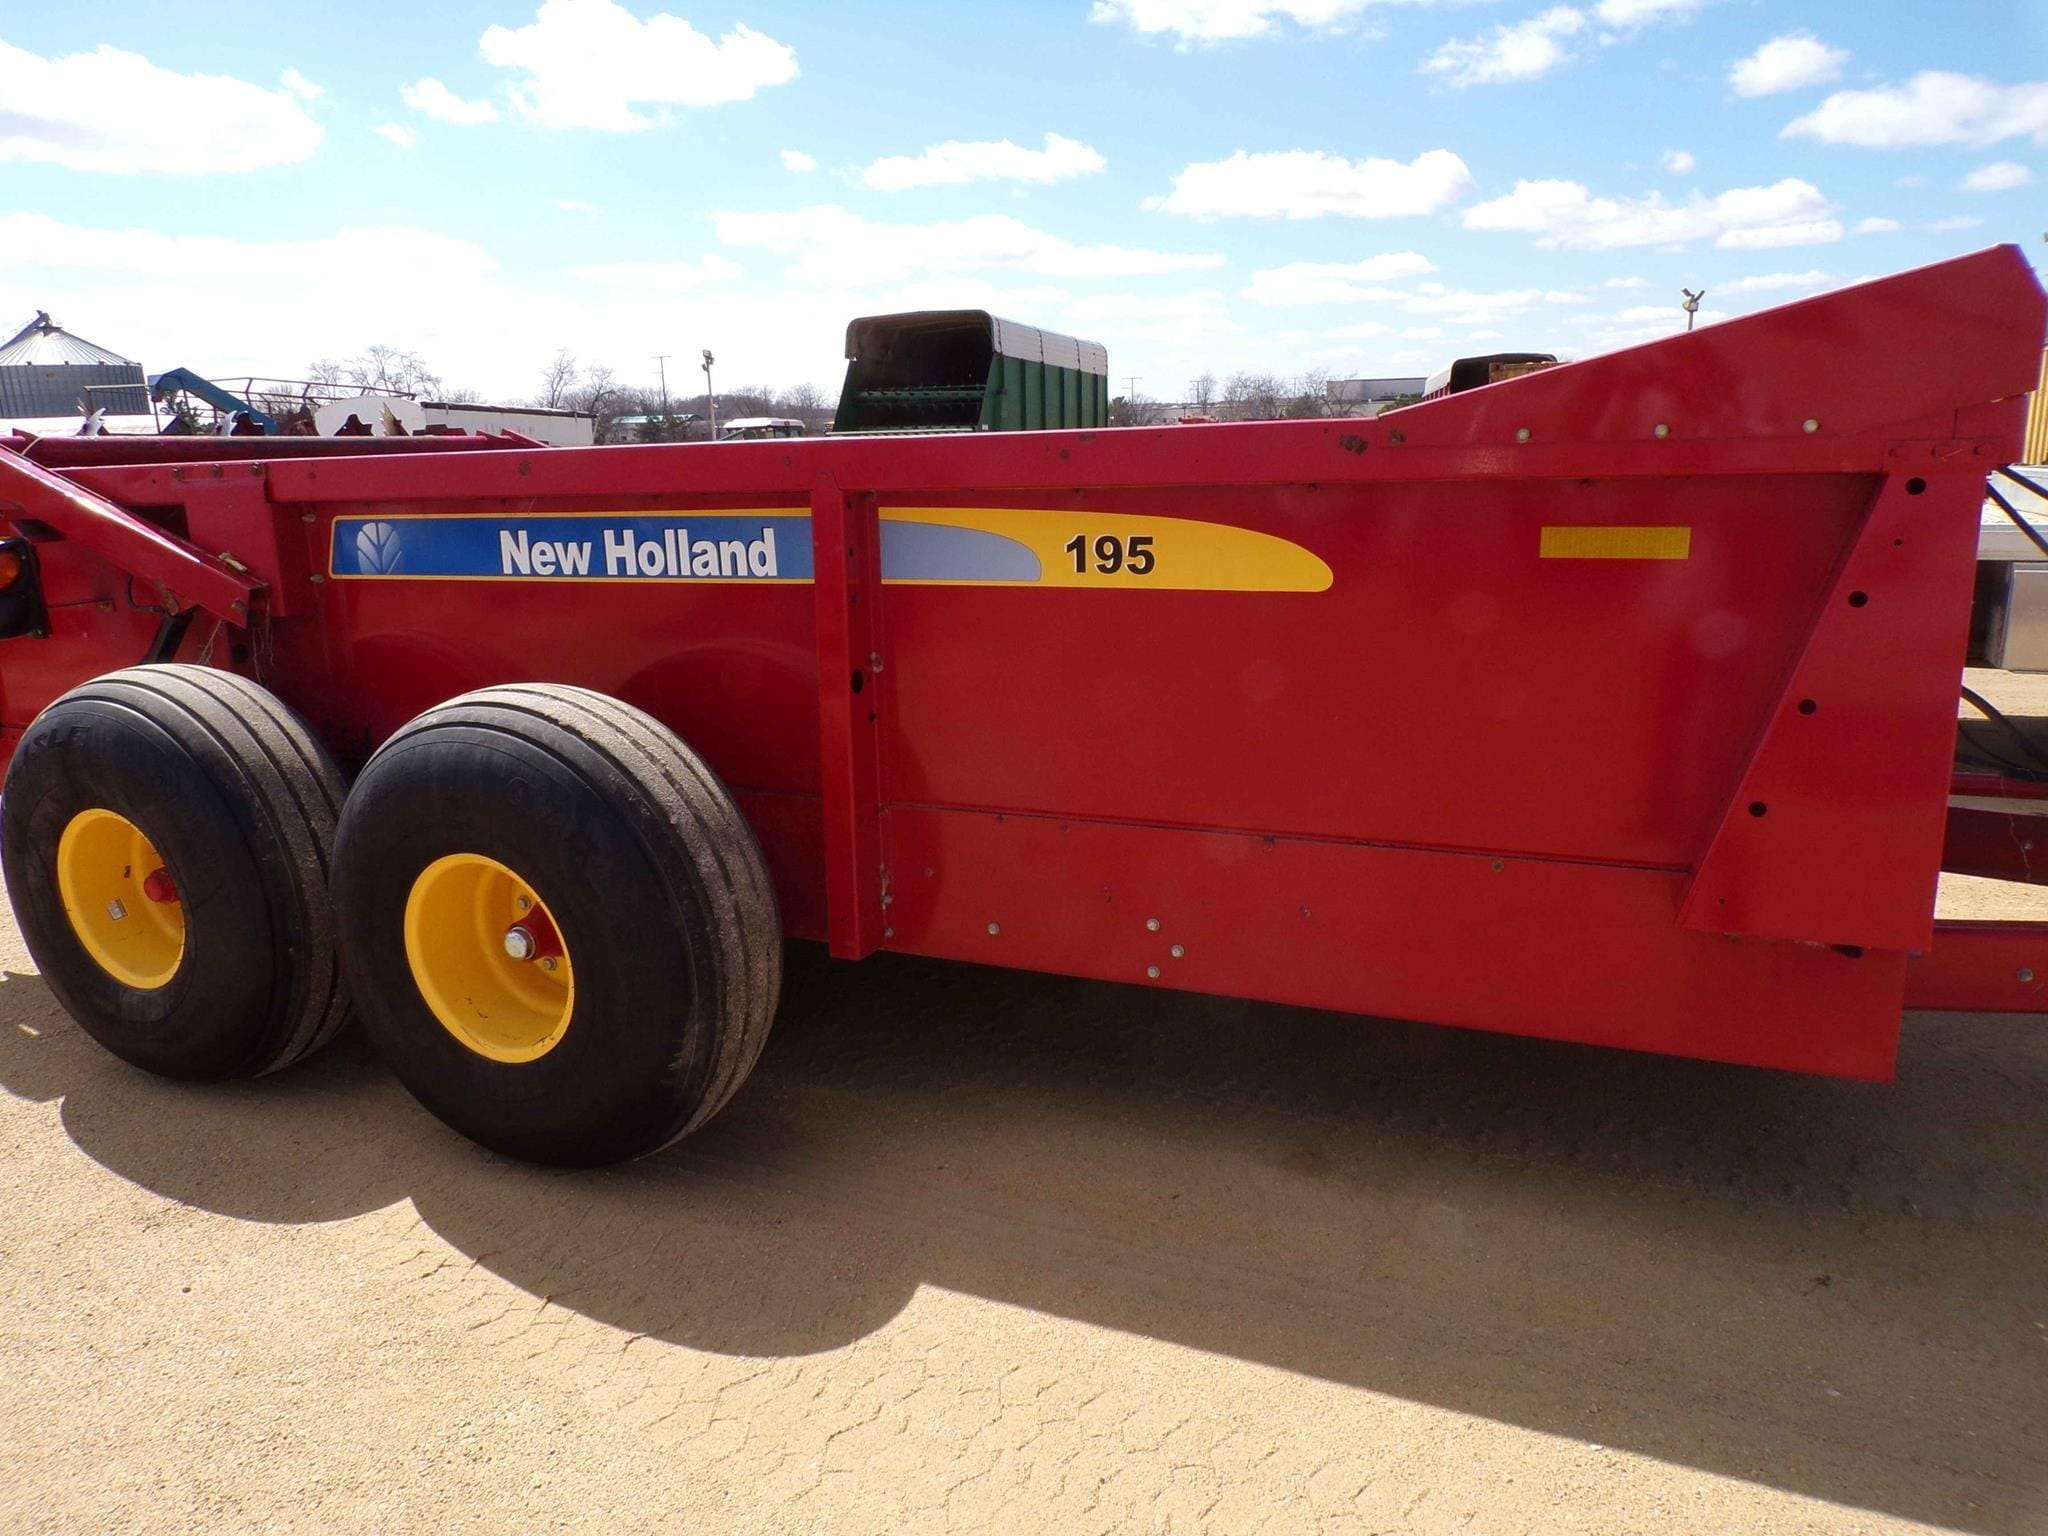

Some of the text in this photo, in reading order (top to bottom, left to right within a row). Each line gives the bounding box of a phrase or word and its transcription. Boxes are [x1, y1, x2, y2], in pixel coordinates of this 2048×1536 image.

[499, 527, 778, 577] New Holland
[1065, 534, 1156, 576] 195
